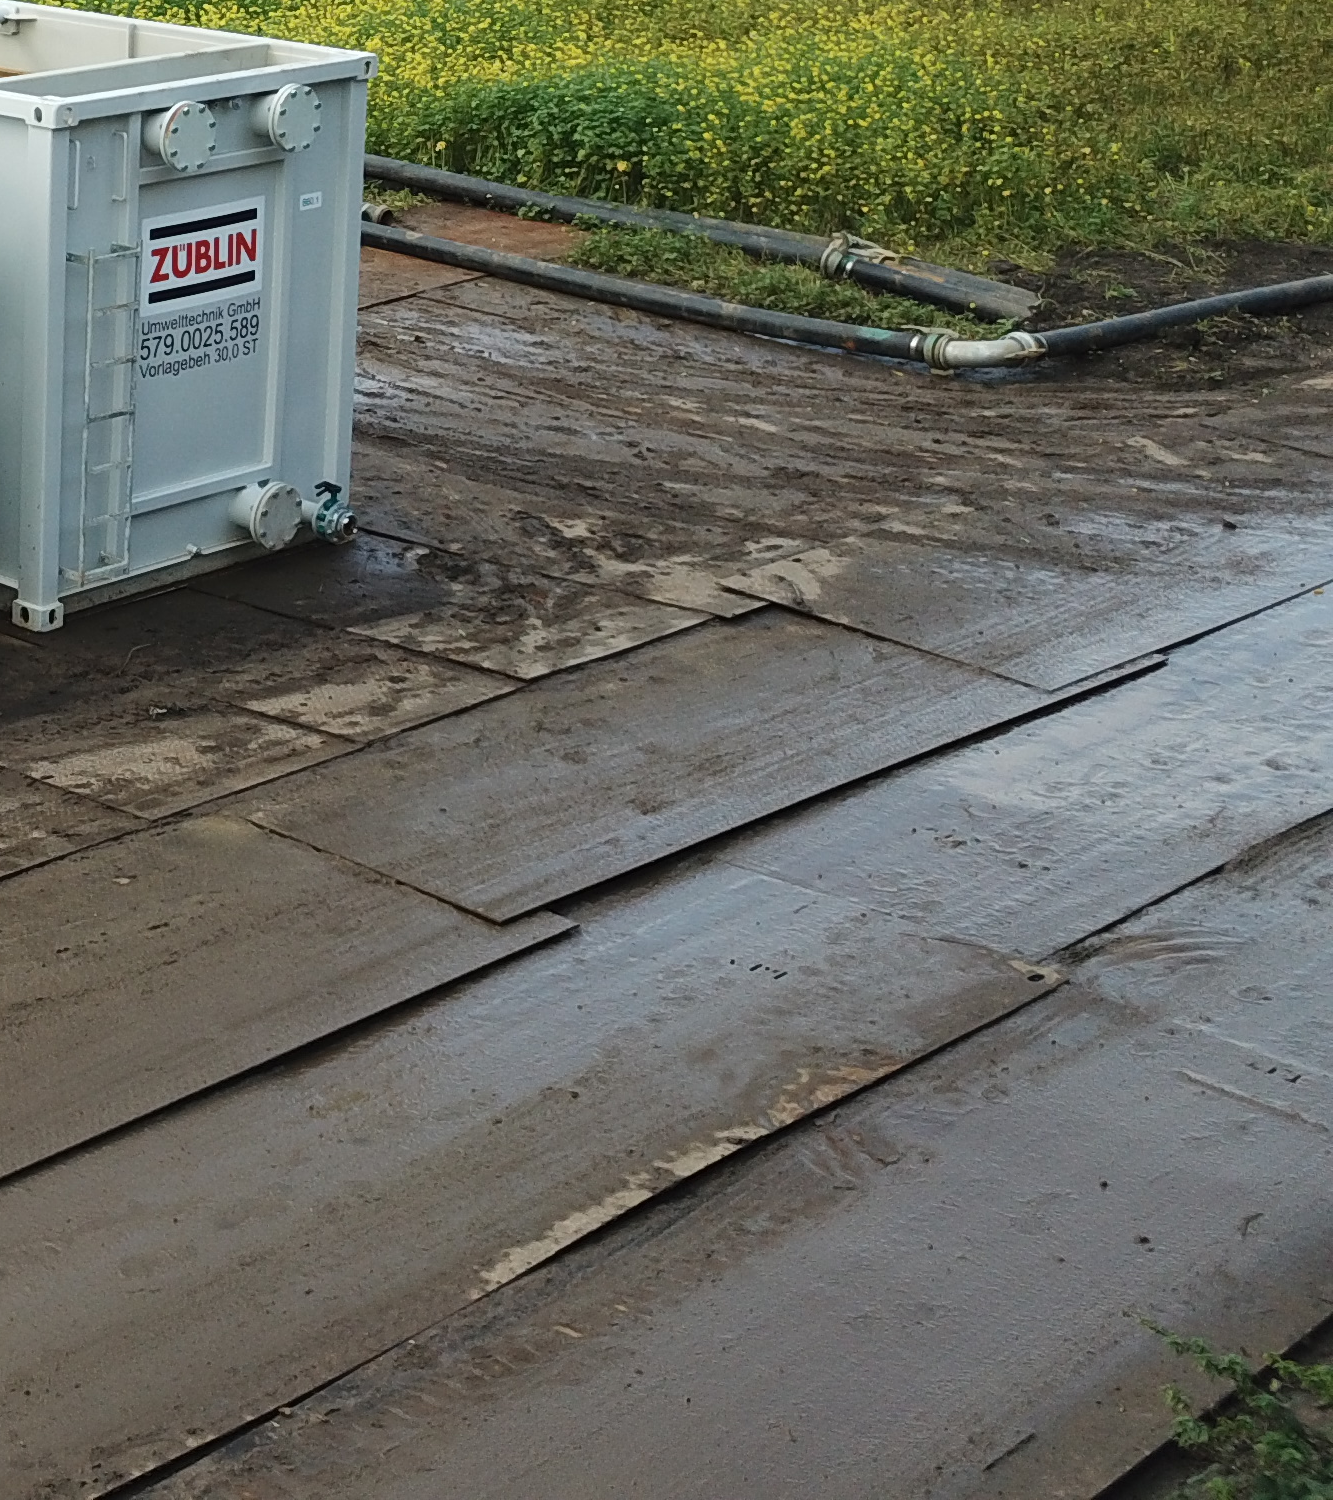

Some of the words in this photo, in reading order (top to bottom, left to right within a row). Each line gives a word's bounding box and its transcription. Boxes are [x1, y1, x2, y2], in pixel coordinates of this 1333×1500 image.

[149, 228, 258, 284] ZÜBLIN
[140, 314, 260, 361] 579.0025.589
[141, 306, 224, 336] Umwelttechnik
[227, 297, 261, 318] GmbH
[139, 352, 211, 379] Vorlagebeh
[214, 343, 239, 364] 30,0
[242, 338, 259, 357] ST
